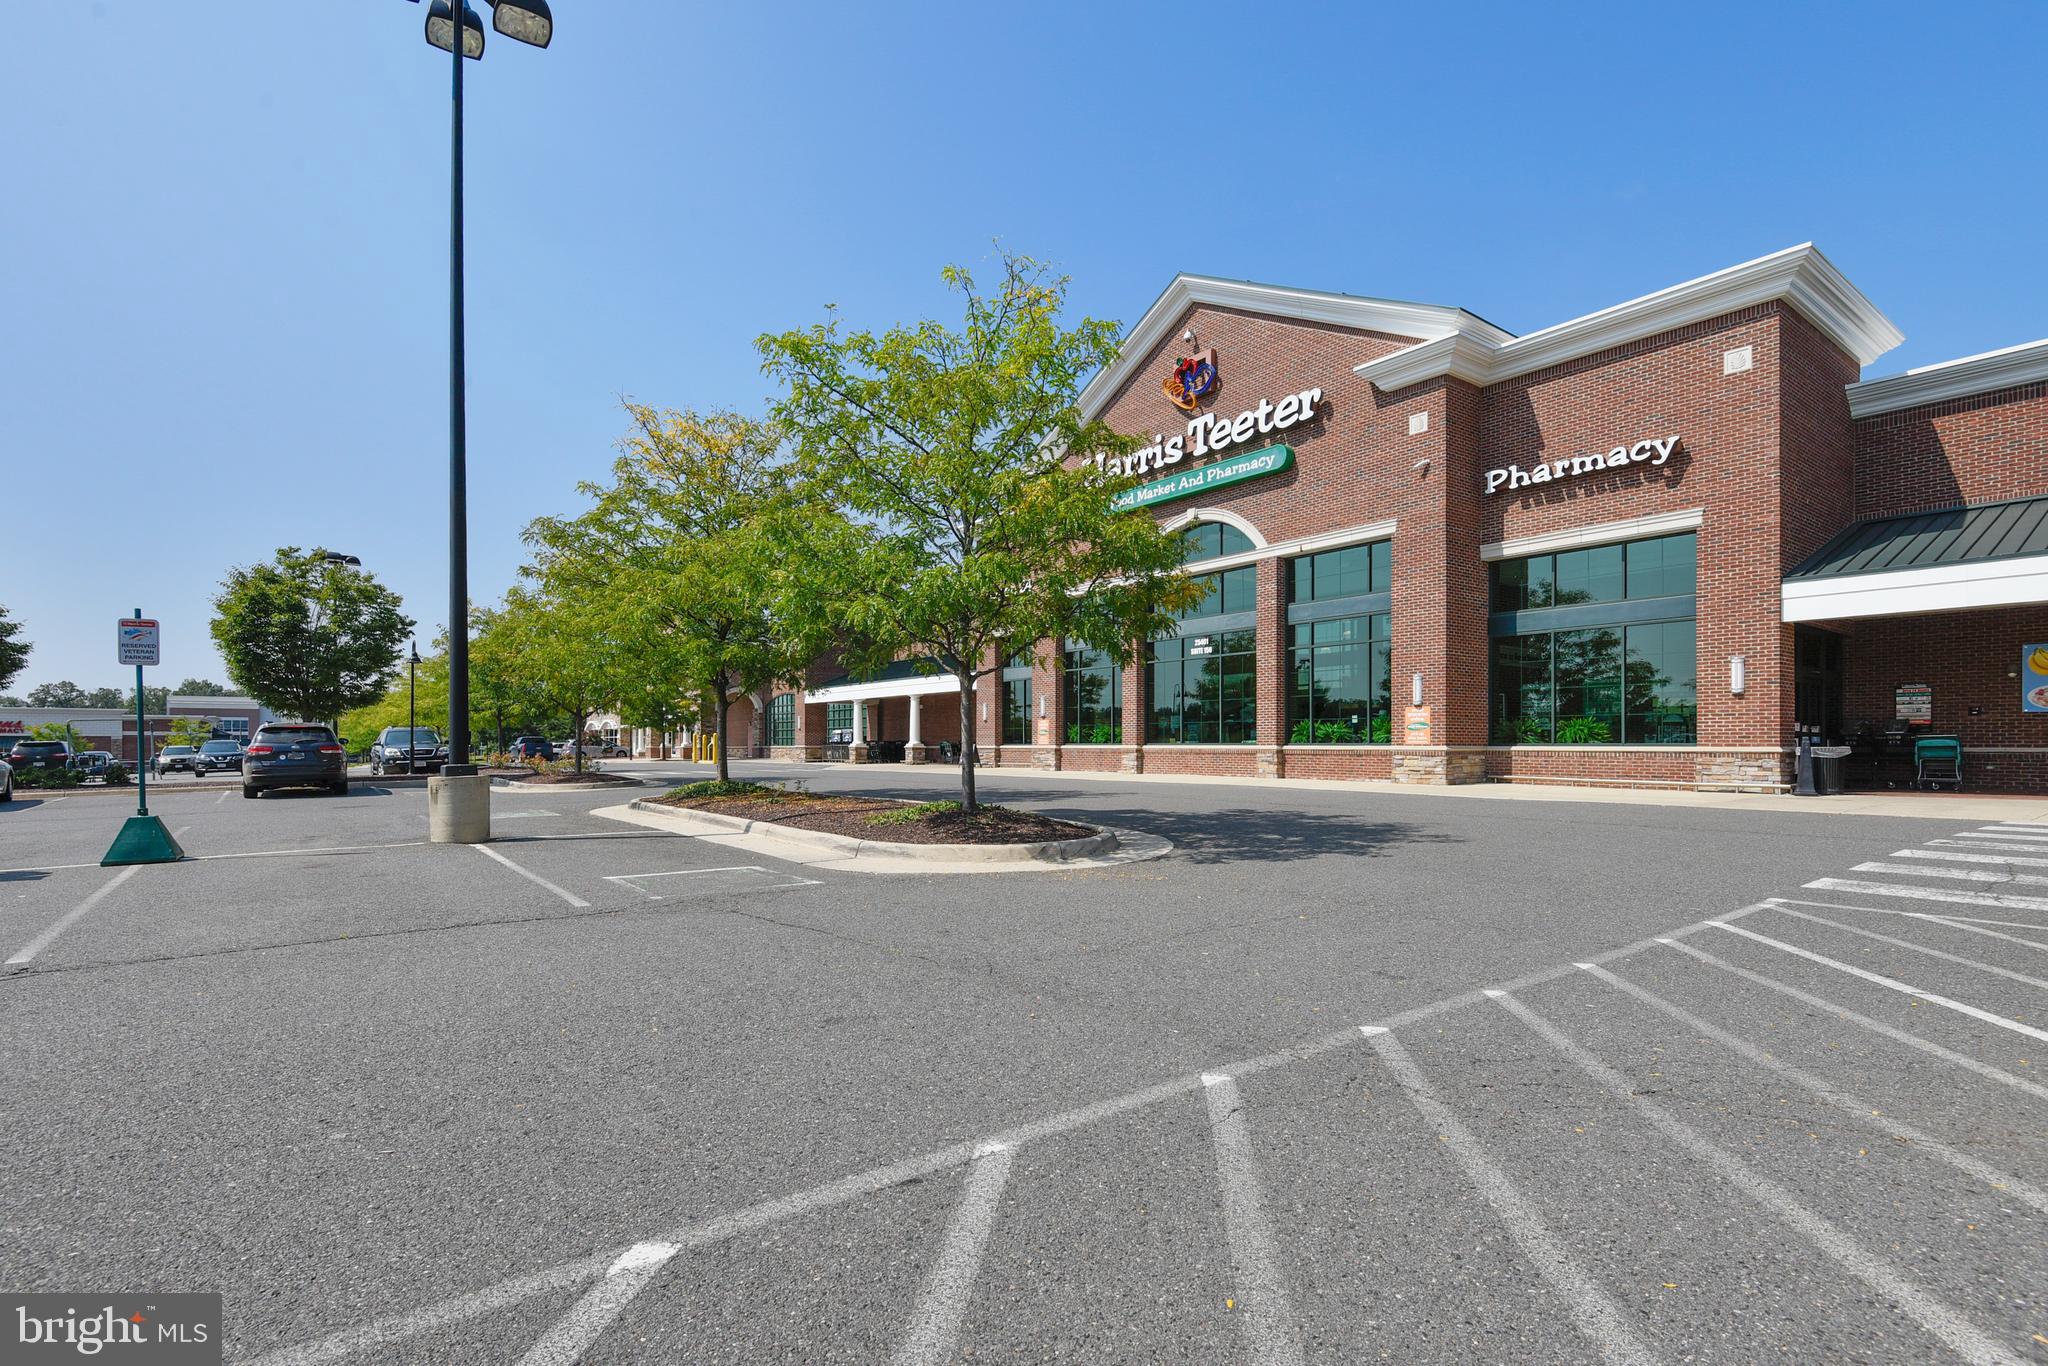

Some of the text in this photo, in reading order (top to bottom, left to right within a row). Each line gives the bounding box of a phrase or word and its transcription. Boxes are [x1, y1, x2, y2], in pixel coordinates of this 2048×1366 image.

[1187, 387, 1322, 457] Teeter
[1137, 481, 1176, 501] Market
[1178, 471, 1204, 490] And
[1207, 455, 1275, 481] Pharmacy
[1484, 435, 1681, 494] Pharmacy
[1190, 648, 1203, 656] SUITE
